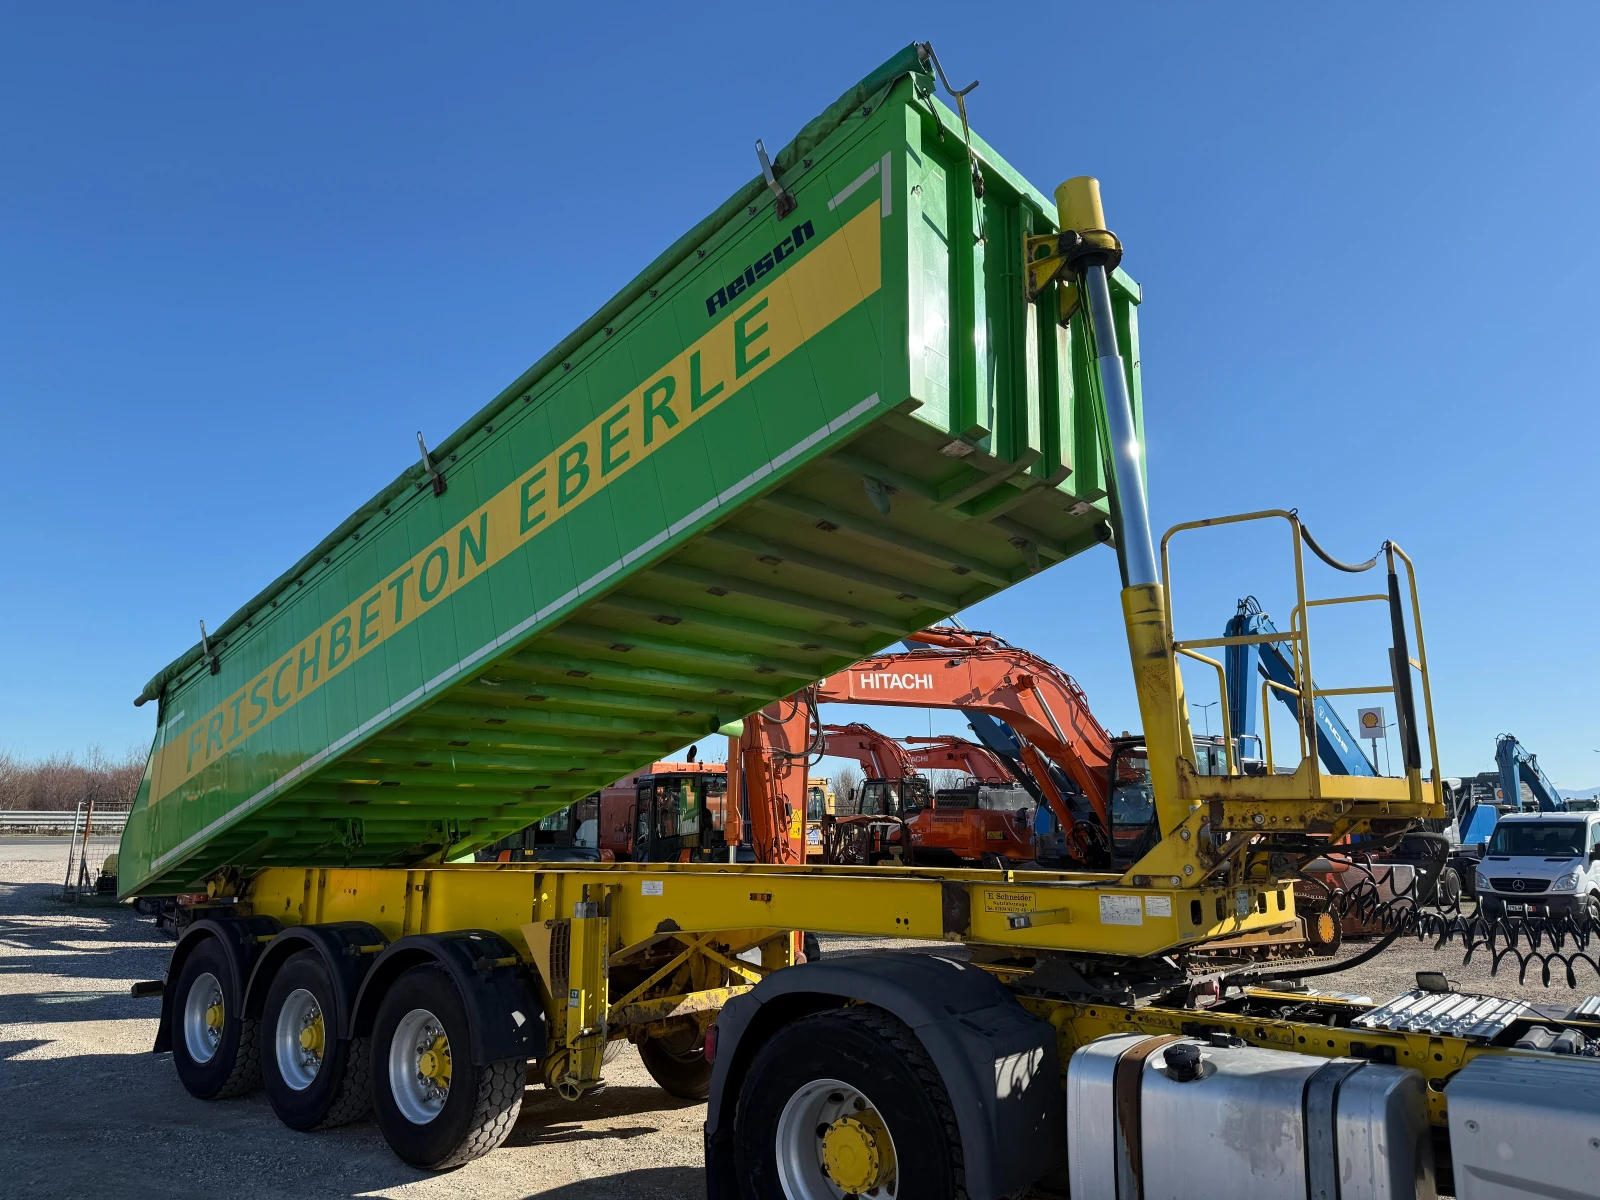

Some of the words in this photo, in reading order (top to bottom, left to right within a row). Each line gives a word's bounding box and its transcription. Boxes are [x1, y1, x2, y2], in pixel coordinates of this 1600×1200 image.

[705, 219, 815, 317] Reisch
[186, 511, 488, 774] FRISCHBETON
[520, 296, 771, 536] EBERLE
[860, 673, 933, 689] HITACHI
[996, 893, 1033, 902] Schneider
